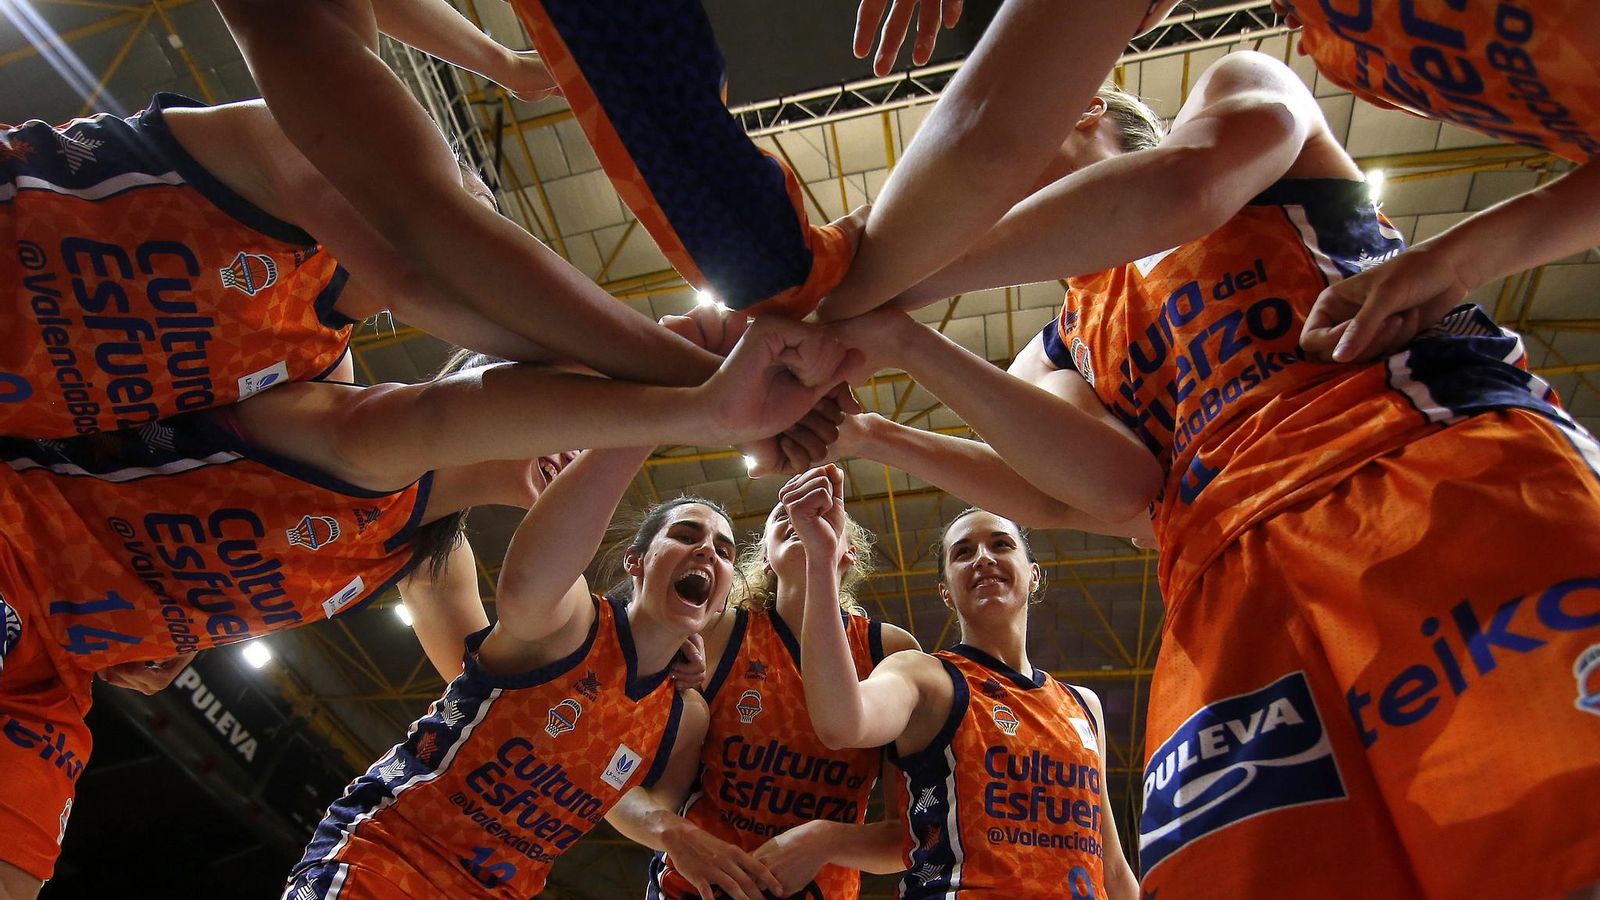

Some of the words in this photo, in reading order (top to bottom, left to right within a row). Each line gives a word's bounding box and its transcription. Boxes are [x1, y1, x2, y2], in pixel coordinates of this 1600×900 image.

[1213, 259, 1267, 300] del
[136, 240, 215, 411] Cultura
[49, 590, 145, 656] 14
[174, 667, 259, 763] PULEVA
[497, 737, 603, 818] Cultura
[722, 735, 848, 785] Cultura
[984, 745, 1100, 795] Cultura
[1142, 697, 1303, 814] PULEVA
[984, 781, 1103, 832] Esfuer
